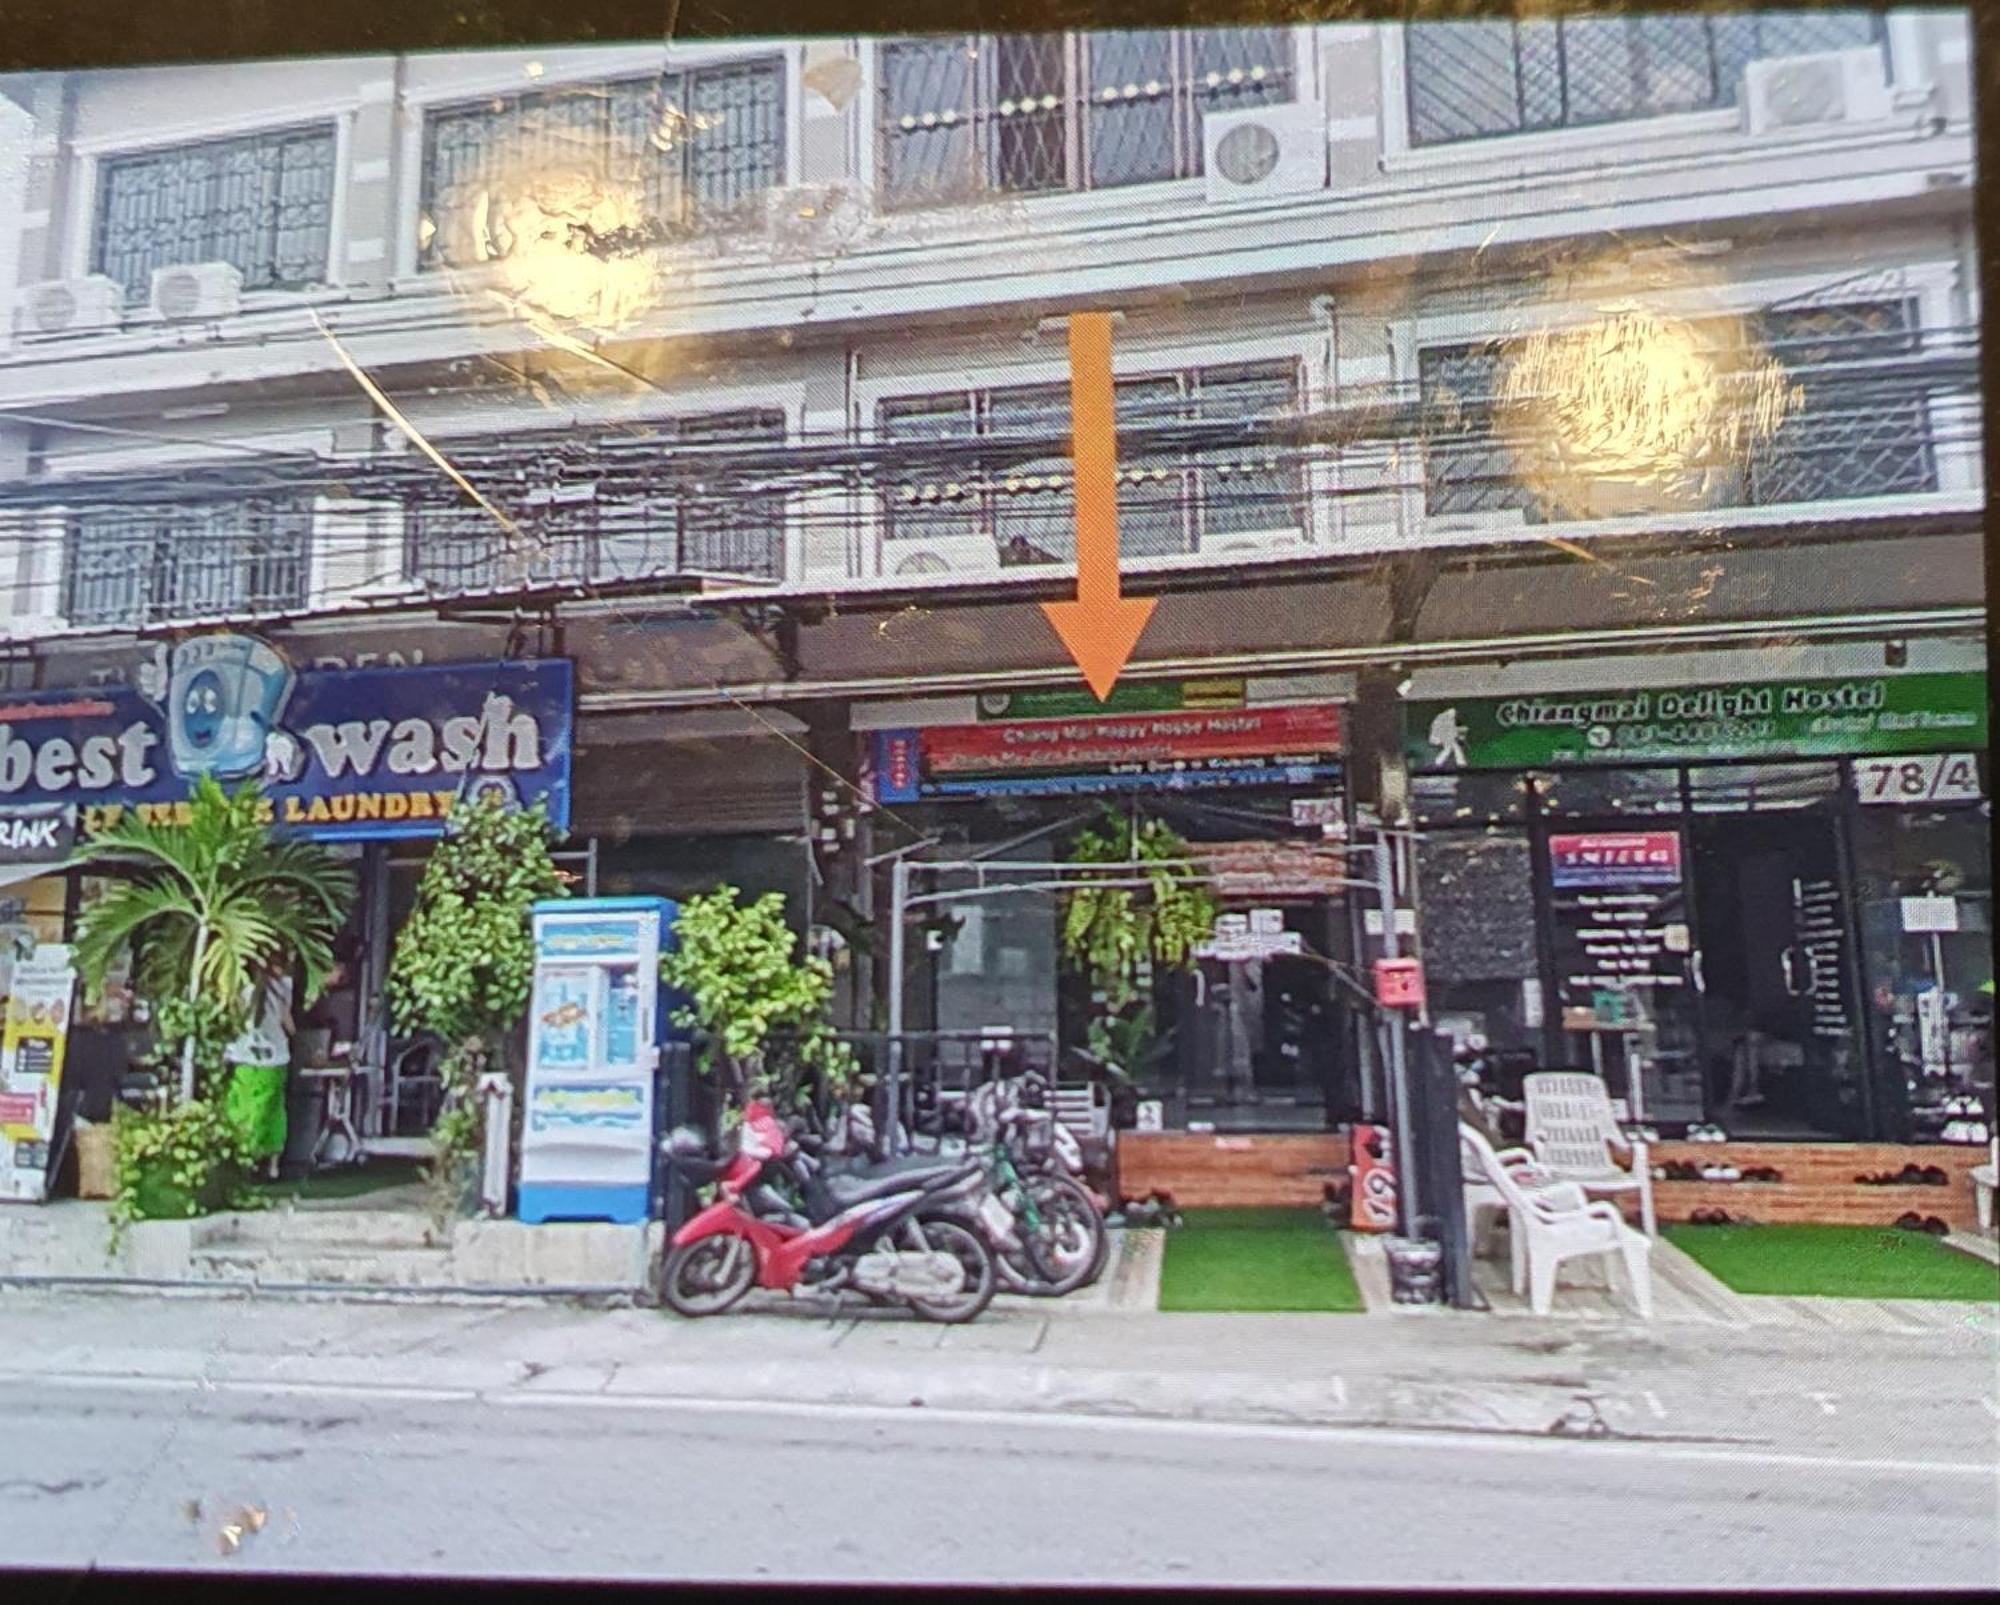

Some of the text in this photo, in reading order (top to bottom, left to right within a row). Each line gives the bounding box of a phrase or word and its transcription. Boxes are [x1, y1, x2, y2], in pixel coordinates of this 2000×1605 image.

[1496, 680, 1887, 729] Chiangmai Delight Hostel
[0, 691, 542, 793] best wash
[1868, 753, 1978, 798] 78/4
[285, 790, 458, 822] LAUNDRY
